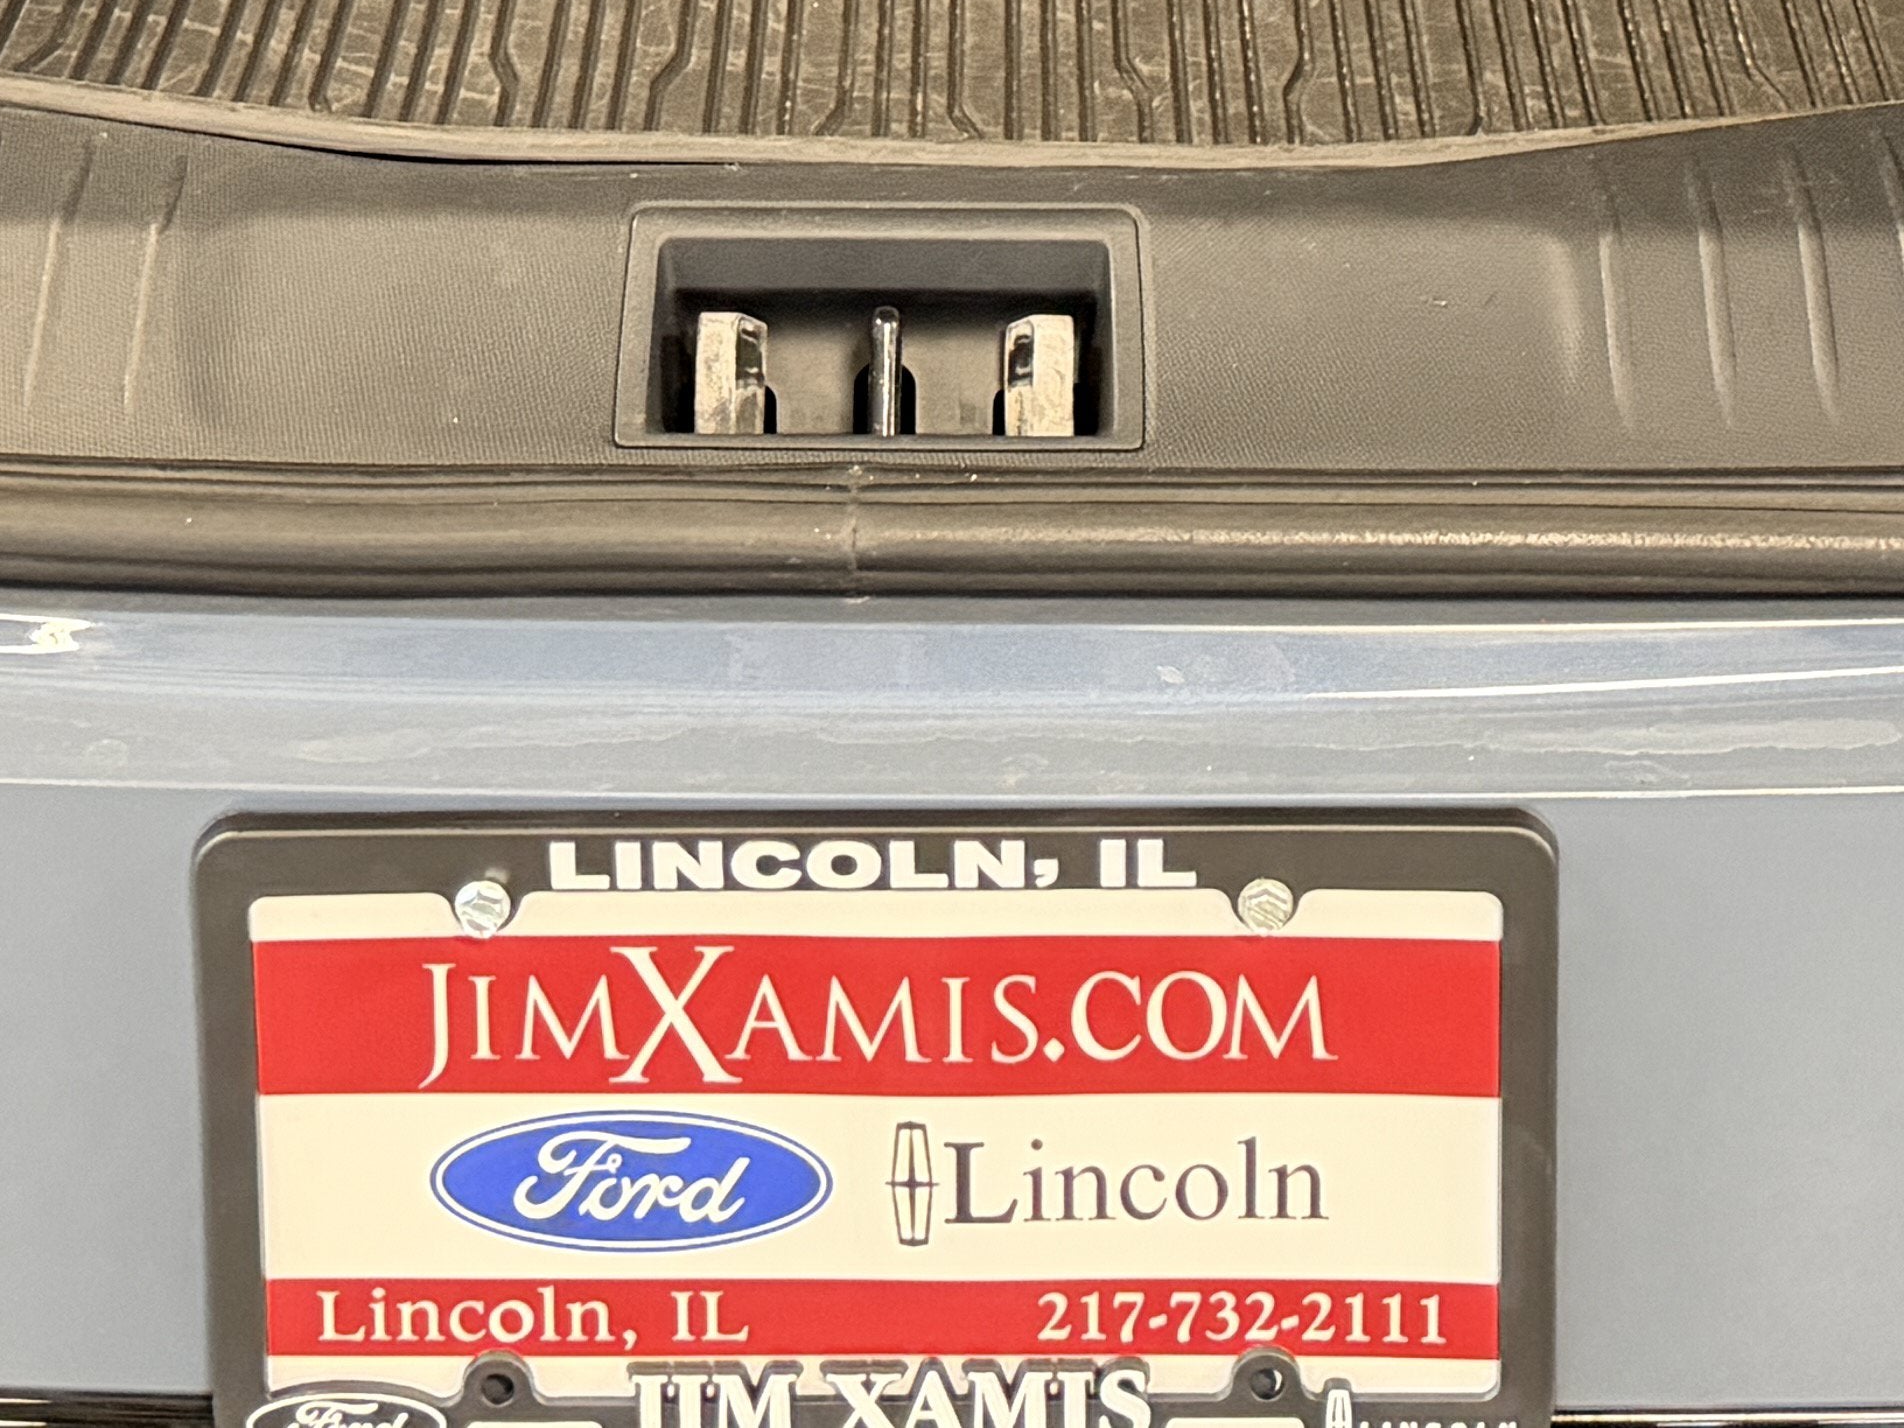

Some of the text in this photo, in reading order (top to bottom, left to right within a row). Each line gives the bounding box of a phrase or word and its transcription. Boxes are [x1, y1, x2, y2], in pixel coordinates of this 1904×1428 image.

[548, 838, 1197, 891] LINCOLN, IL
[512, 1130, 750, 1224] Ford
[944, 1138, 1329, 1225] Lincoln
[317, 1287, 750, 1351] Lincoln, IL
[1036, 1290, 1446, 1345] 217-732-2111
